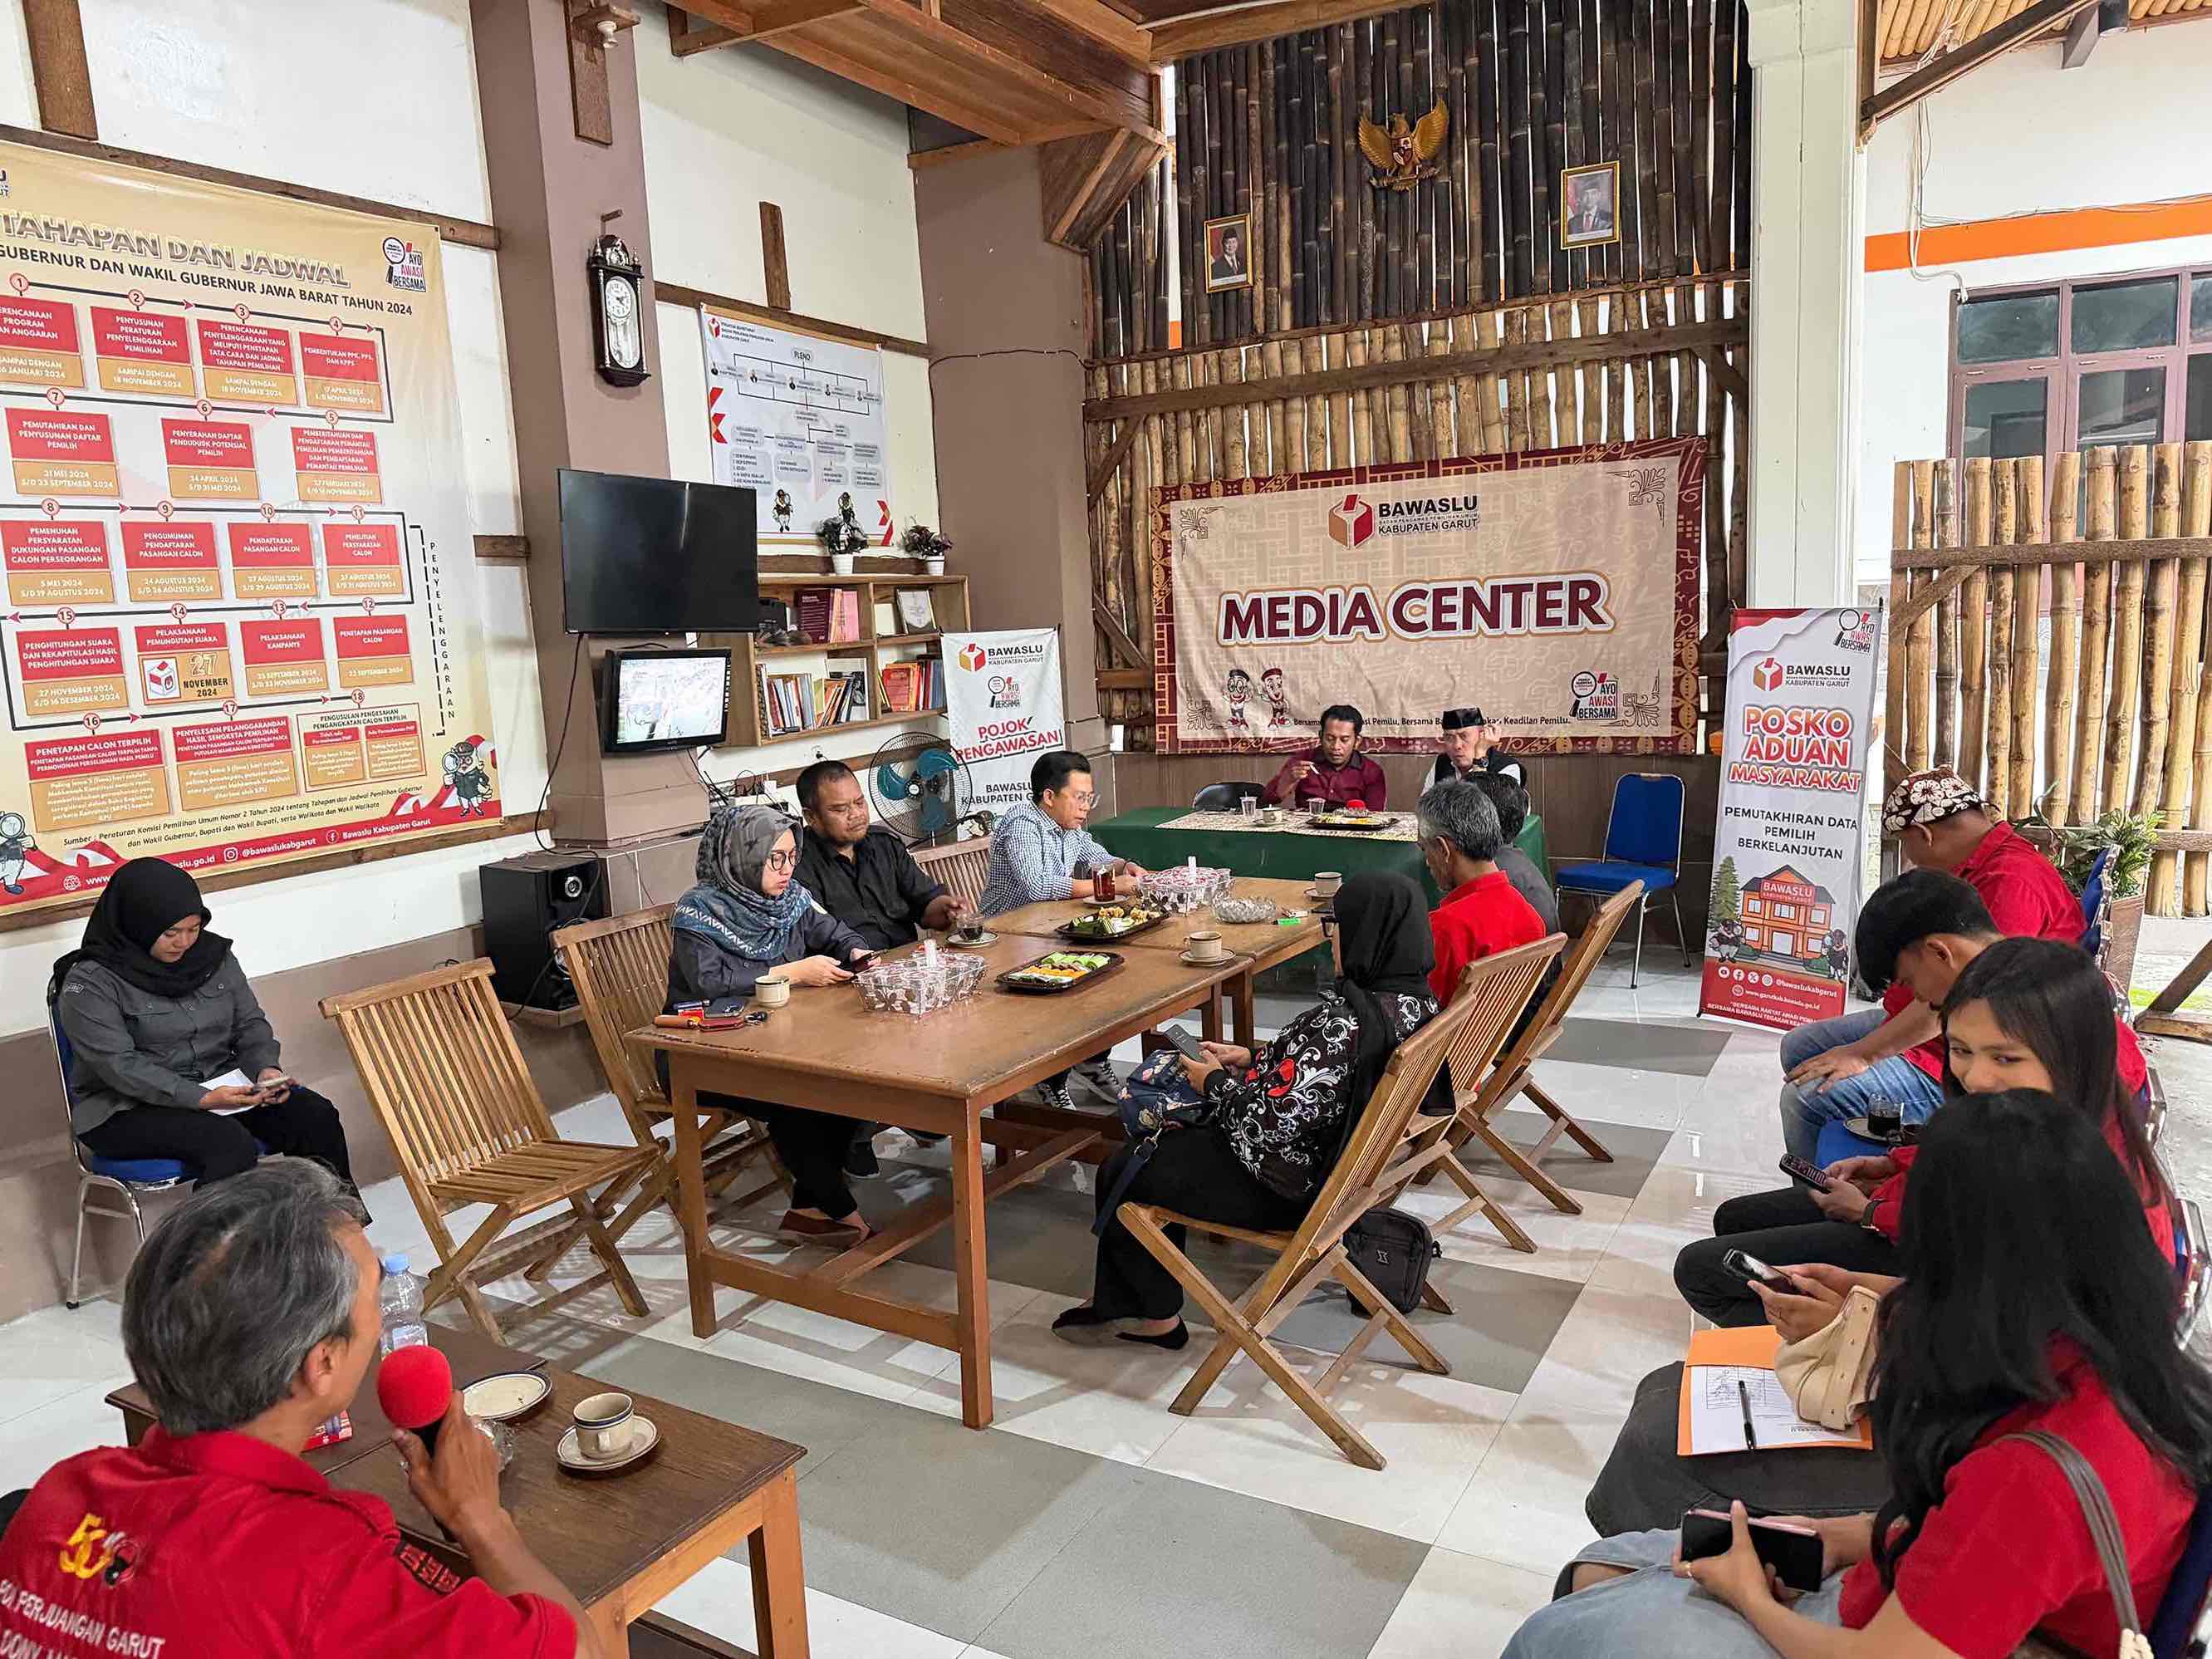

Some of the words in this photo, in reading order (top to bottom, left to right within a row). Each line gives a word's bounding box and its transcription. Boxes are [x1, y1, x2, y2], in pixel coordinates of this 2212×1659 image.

[0, 212, 162, 259] TAHAPAN
[166, 237, 235, 272] DAN
[240, 250, 351, 288] JADWAL
[408, 253, 422, 266] AYO
[90, 258, 125, 275] DAN
[128, 263, 177, 282] WAKIL
[180, 272, 256, 293] GUBERNUR
[259, 282, 297, 300] JAWA
[300, 289, 339, 305] BARAT
[342, 295, 384, 312] TAHUN
[387, 302, 413, 316] 2024
[394, 275, 425, 290] BERSAMA
[3, 317, 44, 327] PROGRAM
[794, 351, 811, 361] PLENO
[1379, 495, 1478, 517] BAWASLU
[1379, 522, 1439, 534] KABUPATEN
[1441, 518, 1478, 530] GARUT
[1223, 590, 1383, 641] MEDIA
[1392, 579, 1608, 634] CENTER
[1861, 623, 1874, 633] AYO
[1851, 631, 1873, 643] AWASI
[988, 645, 1042, 656] BAWASLU
[1841, 639, 1871, 653] BERSAMA
[189, 652, 217, 675] 27
[1787, 665, 1850, 676] BAWASLU
[184, 678, 228, 689] NOVEMBER
[1600, 683, 1616, 695] AYO
[1786, 680, 1825, 688] KABUPATEN
[1588, 696, 1616, 706] AWASI
[1579, 707, 1616, 719] BERSAMA
[978, 718, 1028, 739] POJOK
[1372, 717, 1400, 726] Pemilu,
[1401, 717, 1433, 725] Bersama
[1504, 716, 1537, 725] Keadilan
[1745, 707, 1852, 738] POSKO
[37, 745, 86, 756] PENETAPAN
[87, 742, 115, 751] CALON
[116, 738, 151, 748] TERPILIH
[956, 730, 1059, 762] PENGAWASAN
[1744, 736, 1850, 766] ADUAN
[1730, 763, 1861, 792] MASYARAKAT
[962, 792, 1023, 805] KABUPATEN
[63, 836, 91, 847] Sumber
[99, 828, 135, 840] Peraturan
[137, 824, 161, 834] Komisi
[163, 819, 197, 831] Pemilihan
[198, 816, 218, 825] Umum
[220, 812, 241, 822] Nomor
[249, 807, 268, 815] Tahun
[269, 804, 285, 812] 2024
[1724, 807, 1824, 826] PEMUTAKHIRAN
[1828, 817, 1858, 830] DATA
[127, 838, 141, 847] dan
[143, 835, 162, 845] Wakil
[199, 827, 222, 837] Bupati
[223, 825, 236, 833] dan
[237, 820, 255, 830] Wakil
[326, 808, 336, 817] dan
[343, 828, 371, 839] Bawaslu
[373, 822, 410, 834] Kabupaten
[411, 818, 431, 828] Garut
[1765, 827, 1816, 840] PEMILIH
[1738, 838, 1843, 860] BERKELANJUTAN
[1763, 882, 1812, 897] BAWASLU
[17, 1590, 105, 1647] PERJUANGAN
[106, 1626, 166, 1659] GARUT
